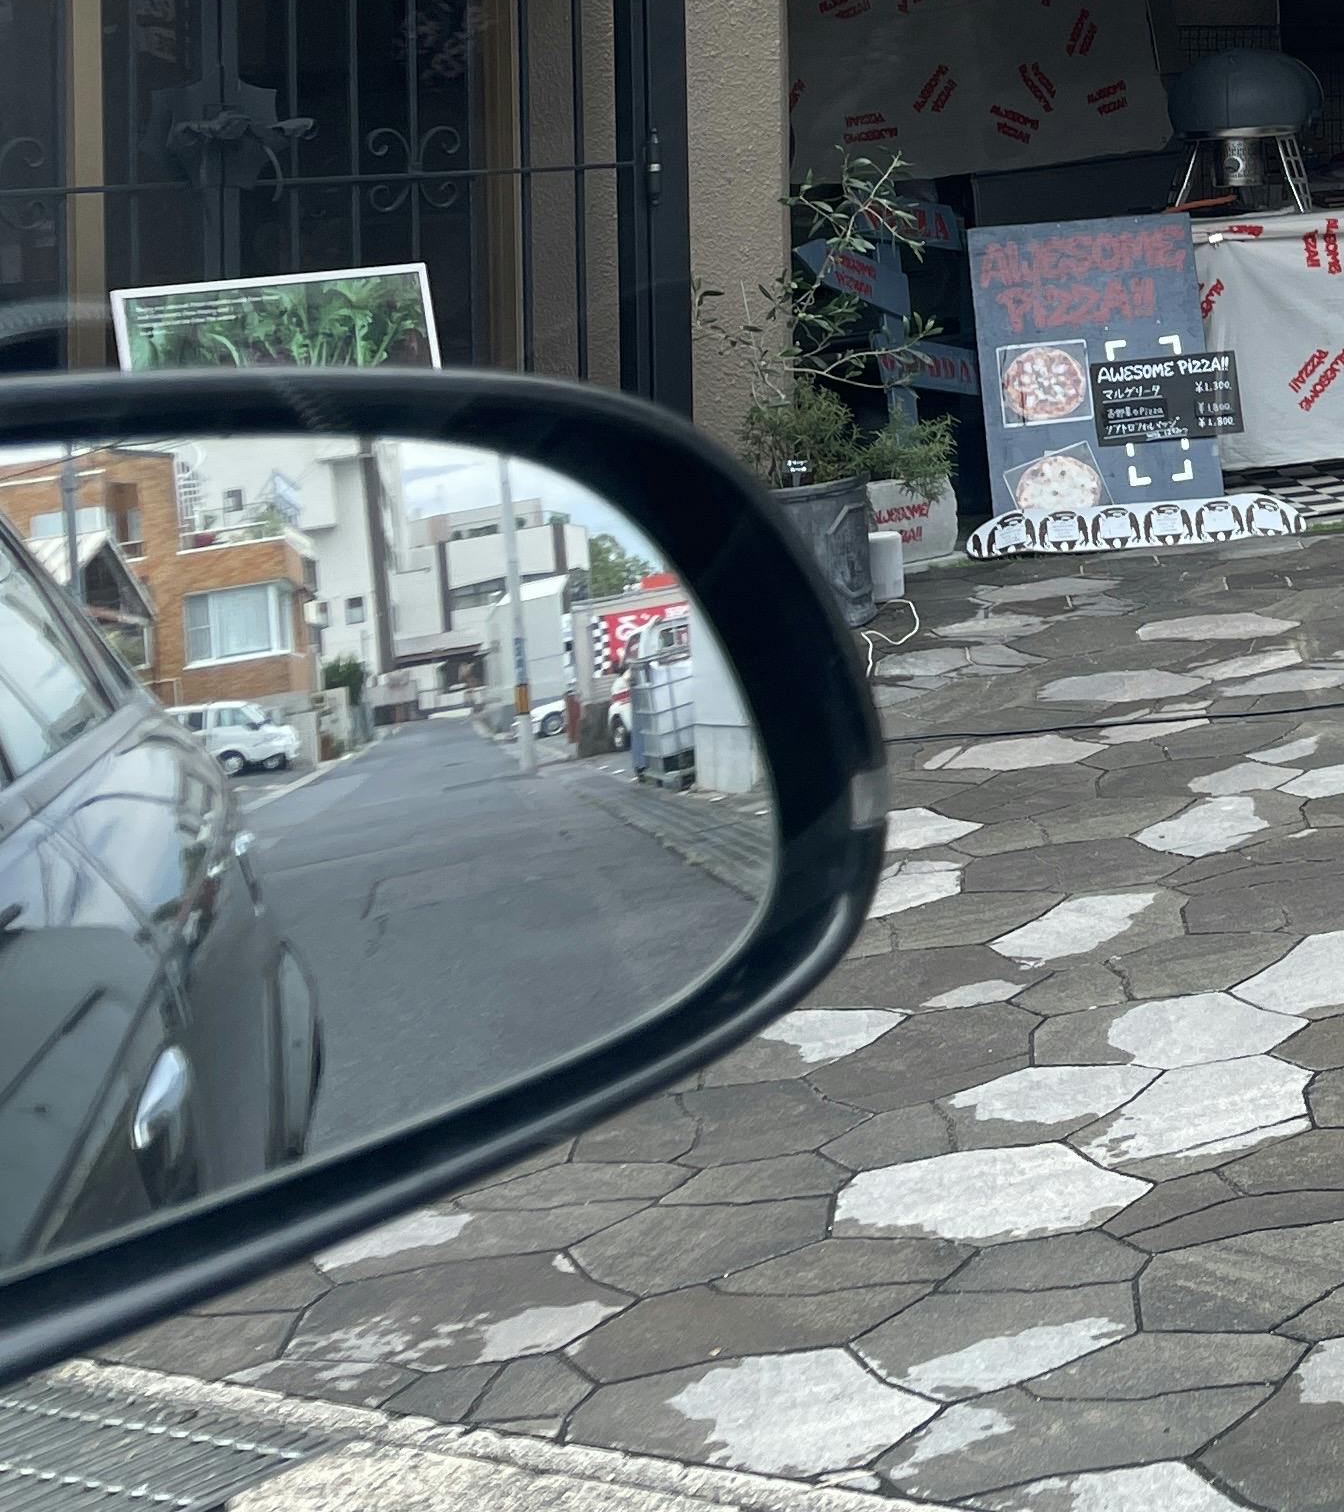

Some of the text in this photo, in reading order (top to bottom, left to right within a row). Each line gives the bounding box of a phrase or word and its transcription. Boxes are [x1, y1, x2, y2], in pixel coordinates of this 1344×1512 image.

[980, 225, 1186, 287] AWESOME
[1098, 362, 1174, 383] AWESOME
[1102, 385, 1161, 400] マルゲリータ
